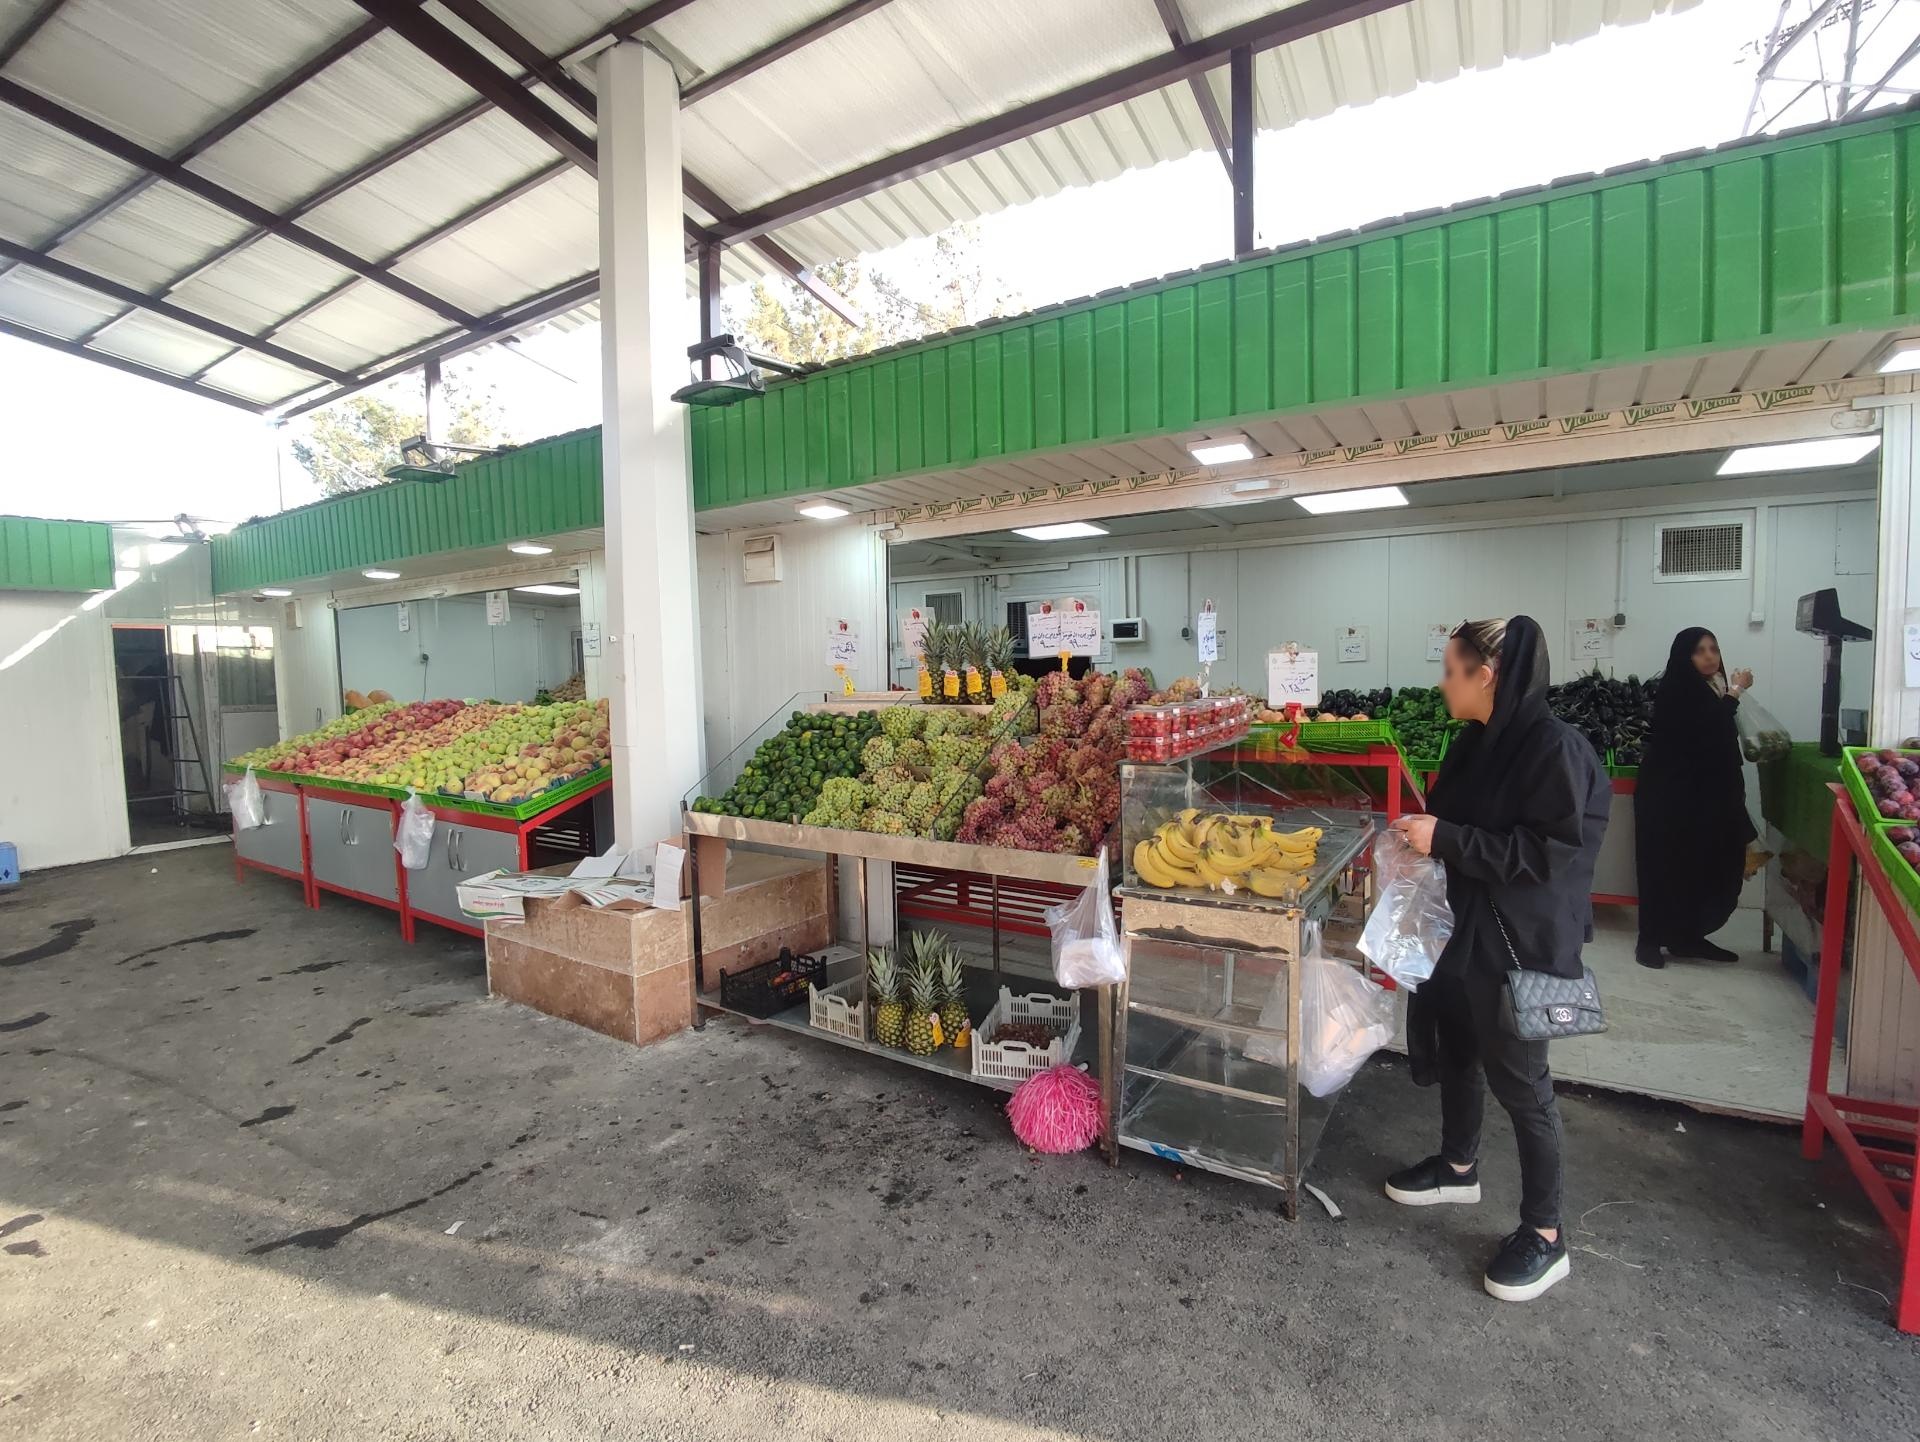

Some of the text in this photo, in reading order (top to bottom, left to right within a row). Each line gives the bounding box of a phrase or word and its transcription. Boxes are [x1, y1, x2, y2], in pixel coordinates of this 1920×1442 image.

[1297, 450, 1336, 466] VICTORY
[1343, 442, 1384, 461] VICTORY
[1395, 435, 1438, 454] VICTORY
[1445, 428, 1492, 448] VICTORY
[1501, 420, 1551, 440] VICTORY
[1559, 412, 1610, 433] VICTORY
[1621, 403, 1676, 425] VICTORY
[1683, 395, 1742, 418] VICTORY
[1752, 385, 1815, 409] VICTORY
[926, 502, 952, 517] VICTORY
[987, 493, 1015, 509] VICTORY
[1018, 489, 1047, 504] VICTORY
[1053, 484, 1084, 499] VICTORY
[1089, 479, 1120, 494] VICTORY
[1127, 473, 1160, 489] VICTORY
